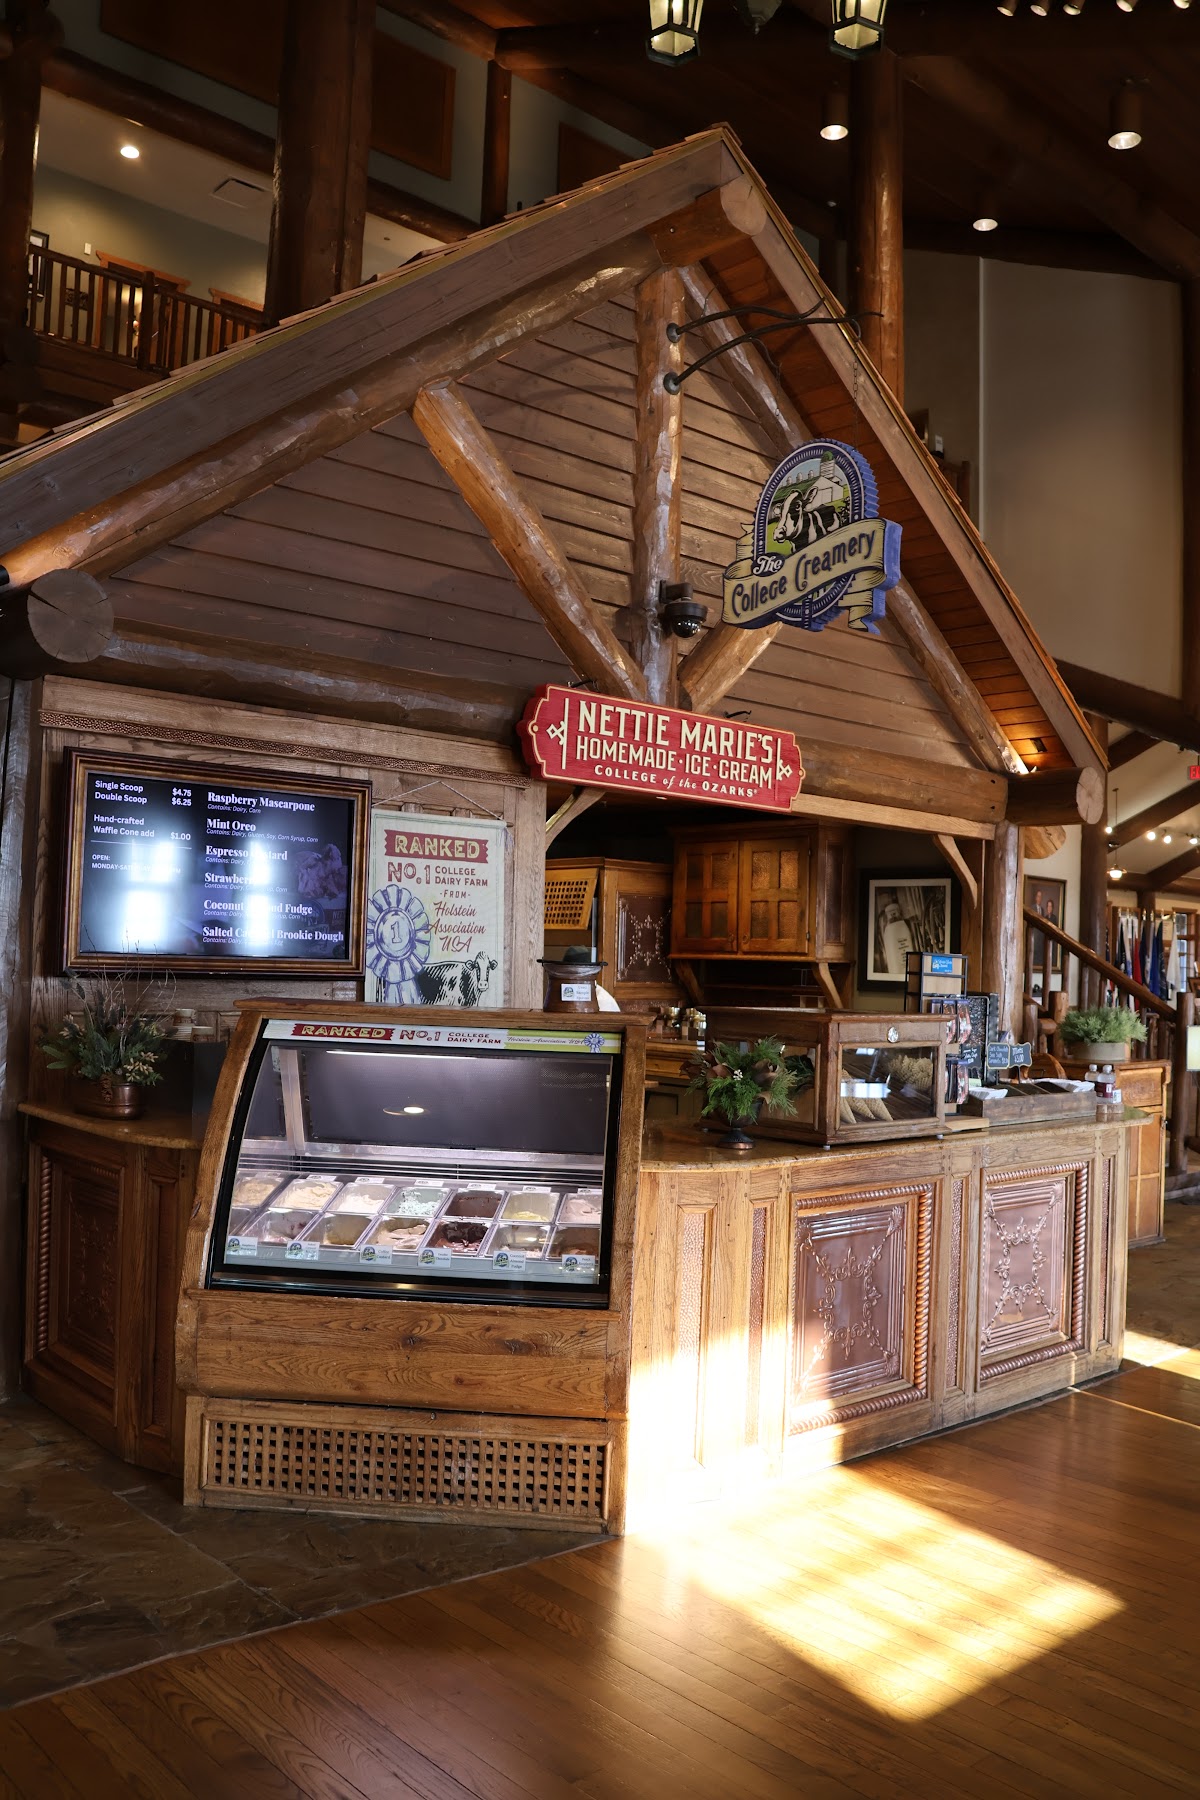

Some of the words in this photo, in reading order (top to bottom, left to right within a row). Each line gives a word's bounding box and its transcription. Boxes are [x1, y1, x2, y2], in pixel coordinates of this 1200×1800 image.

[753, 555, 783, 575] The
[795, 530, 877, 592] Creamery
[577, 700, 670, 746] NETTIE
[680, 719, 773, 764] MARIE'S
[576, 734, 677, 772] HOMEMADE
[684, 757, 711, 777] ICE
[718, 759, 773, 790] CREAM
[594, 764, 657, 784] COLLEGE
[662, 776, 676, 790] of
[679, 777, 697, 789] the
[95, 780, 119, 791] Single
[119, 783, 144, 793] Scoop
[172, 787, 192, 797] $4.75
[94, 792, 122, 801] Double
[123, 794, 148, 804] Scoop
[171, 797, 192, 806] $6.25
[207, 791, 258, 808] Raspberry
[259, 797, 315, 812] Mascarpone
[207, 804, 232, 812] Contains:
[232, 806, 248, 814] Dairy,
[93, 814, 145, 825] Hand-crafted
[207, 818, 230, 830] Mint
[232, 820, 257, 832] Oreo
[93, 826, 118, 835] Waffle
[119, 828, 139, 836] Cone
[140, 830, 155, 838] add
[170, 832, 191, 841] $1.00
[206, 828, 231, 836] Contains:
[231, 830, 247, 838] Dairy,
[206, 845, 249, 858] Espresso
[394, 835, 480, 859] RANKED
[435, 866, 476, 876] COLLEGE
[435, 876, 462, 886] DAIRY
[464, 878, 488, 887] FARM
[203, 899, 244, 911] Coconut
[284, 903, 313, 916] Fudge
[433, 900, 477, 918] Holstein
[202, 926, 233, 937] Salted
[276, 930, 313, 940] Brookie
[314, 931, 344, 943] Dough
[390, 921, 402, 944] 1
[424, 919, 486, 936] Association
[439, 935, 472, 953] USA
[301, 1025, 386, 1038] RANKED
